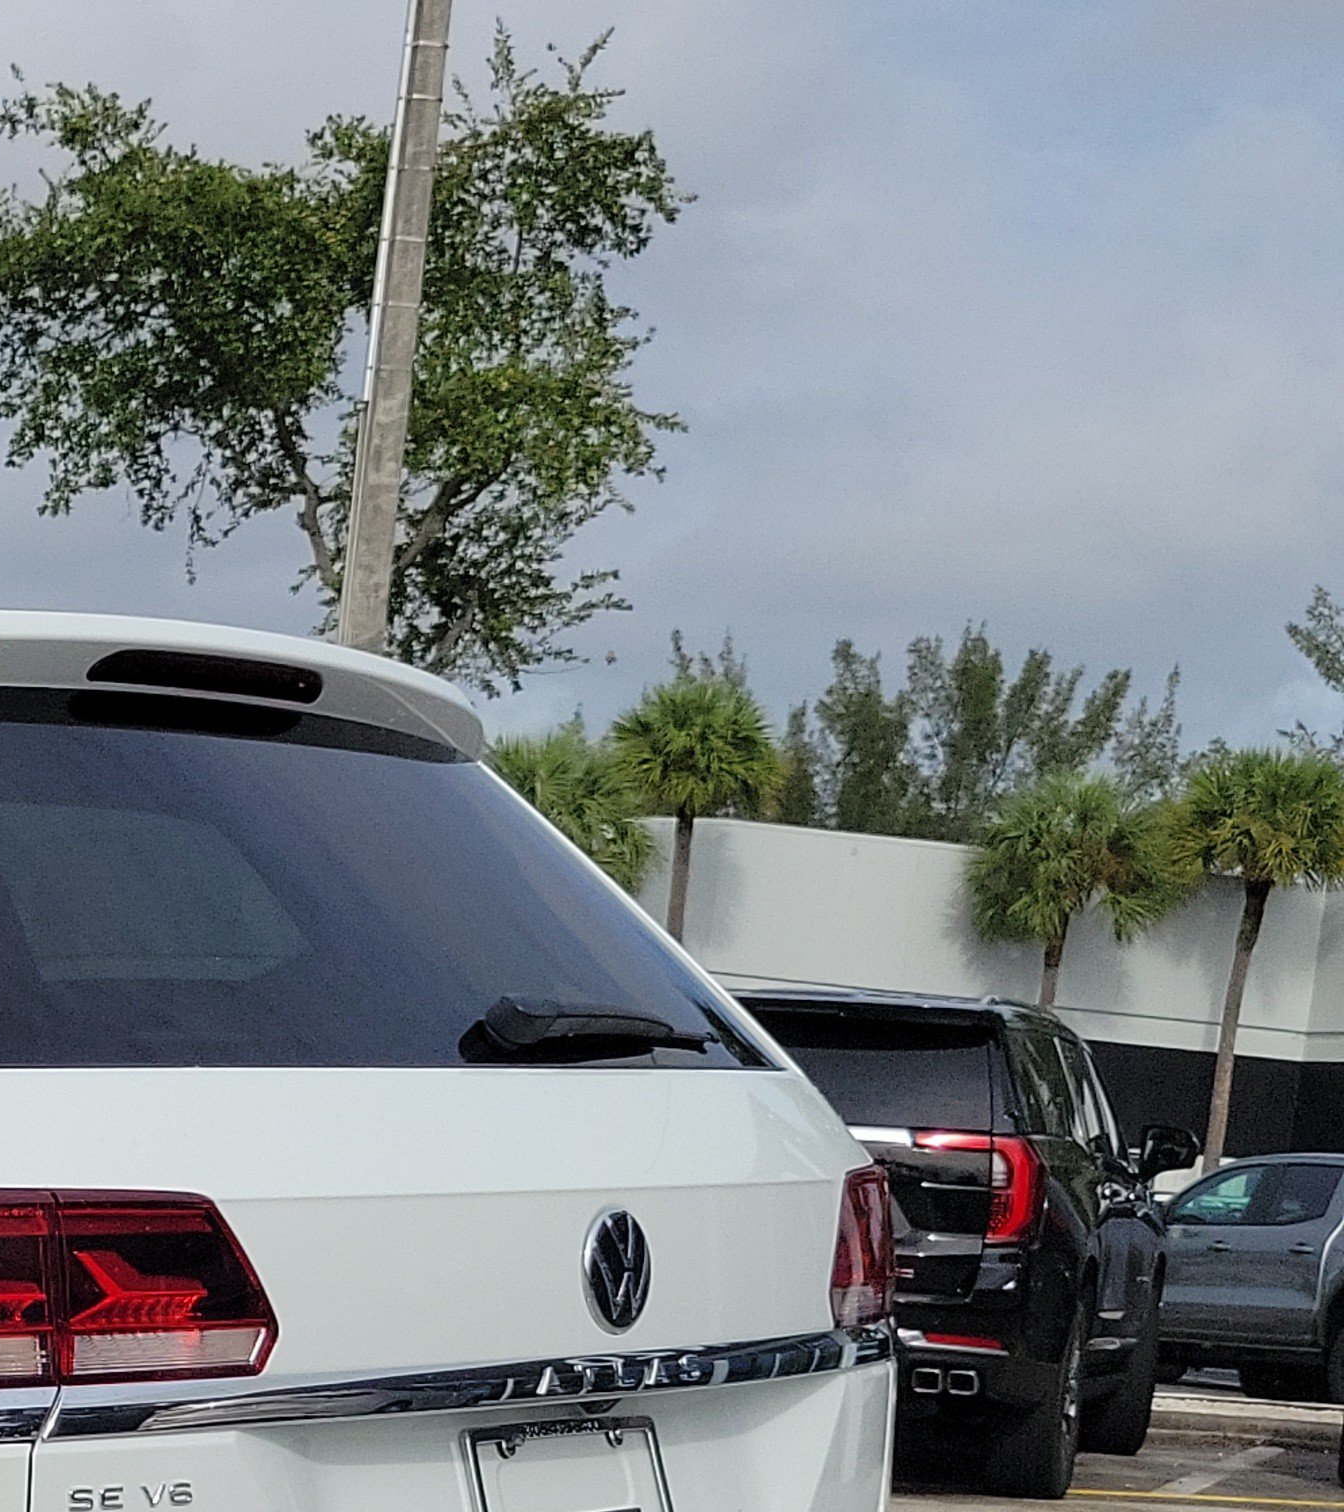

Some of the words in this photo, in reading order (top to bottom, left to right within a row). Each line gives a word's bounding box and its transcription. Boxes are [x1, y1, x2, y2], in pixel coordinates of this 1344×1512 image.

[535, 1353, 701, 1396] ATLAS
[68, 1486, 124, 1512] SE
[140, 1481, 193, 1508] V6
